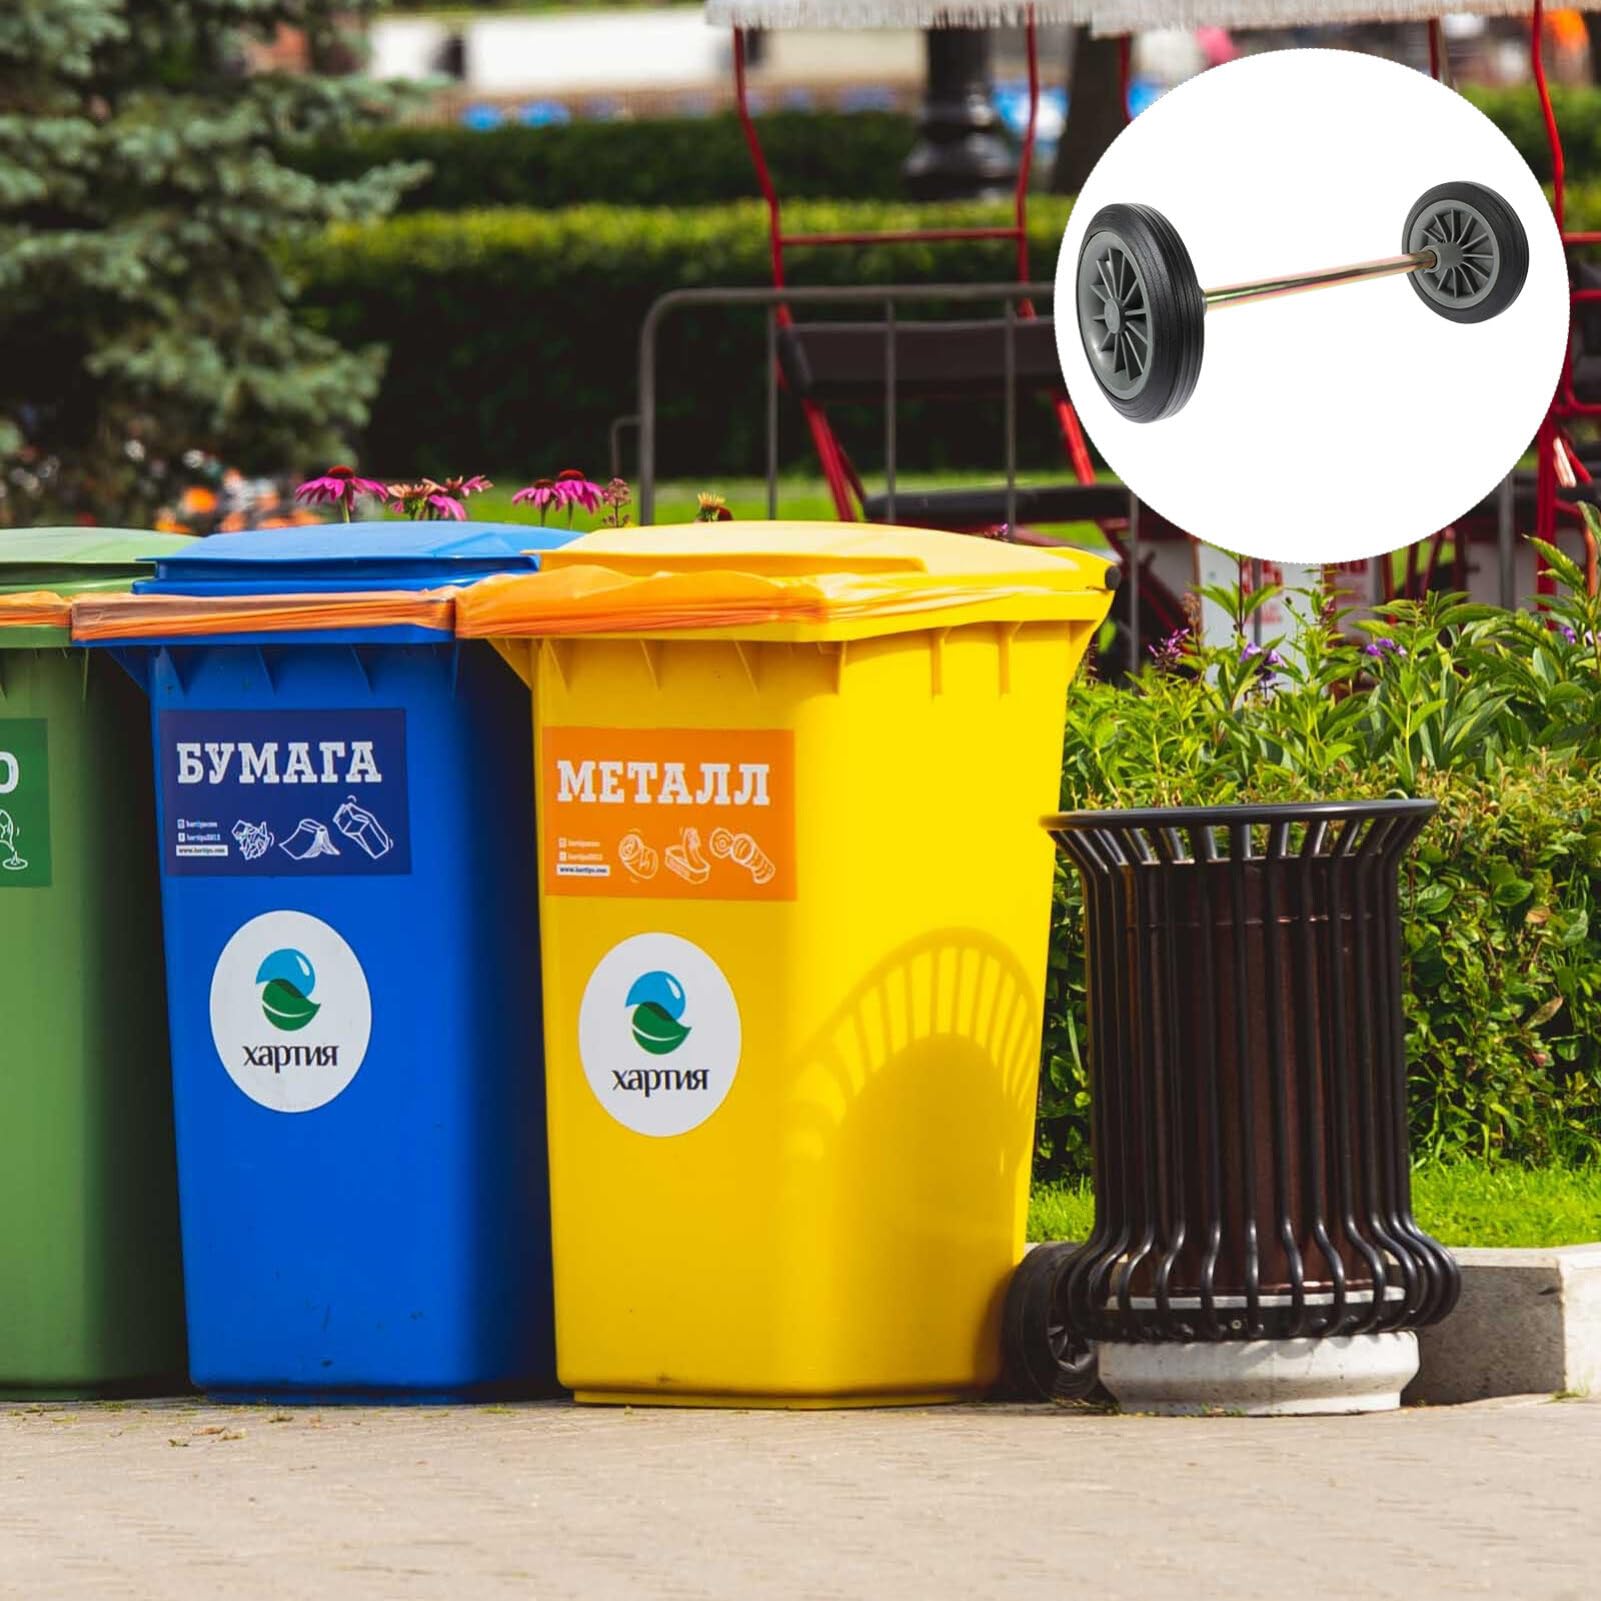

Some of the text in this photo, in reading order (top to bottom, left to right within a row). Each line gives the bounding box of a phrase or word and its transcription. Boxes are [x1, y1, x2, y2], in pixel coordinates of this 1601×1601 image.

[177, 741, 382, 784] БУМАГА
[556, 760, 769, 806] МЕТАЛЛ
[242, 1045, 339, 1074] хартия
[612, 1069, 709, 1098] хартия
